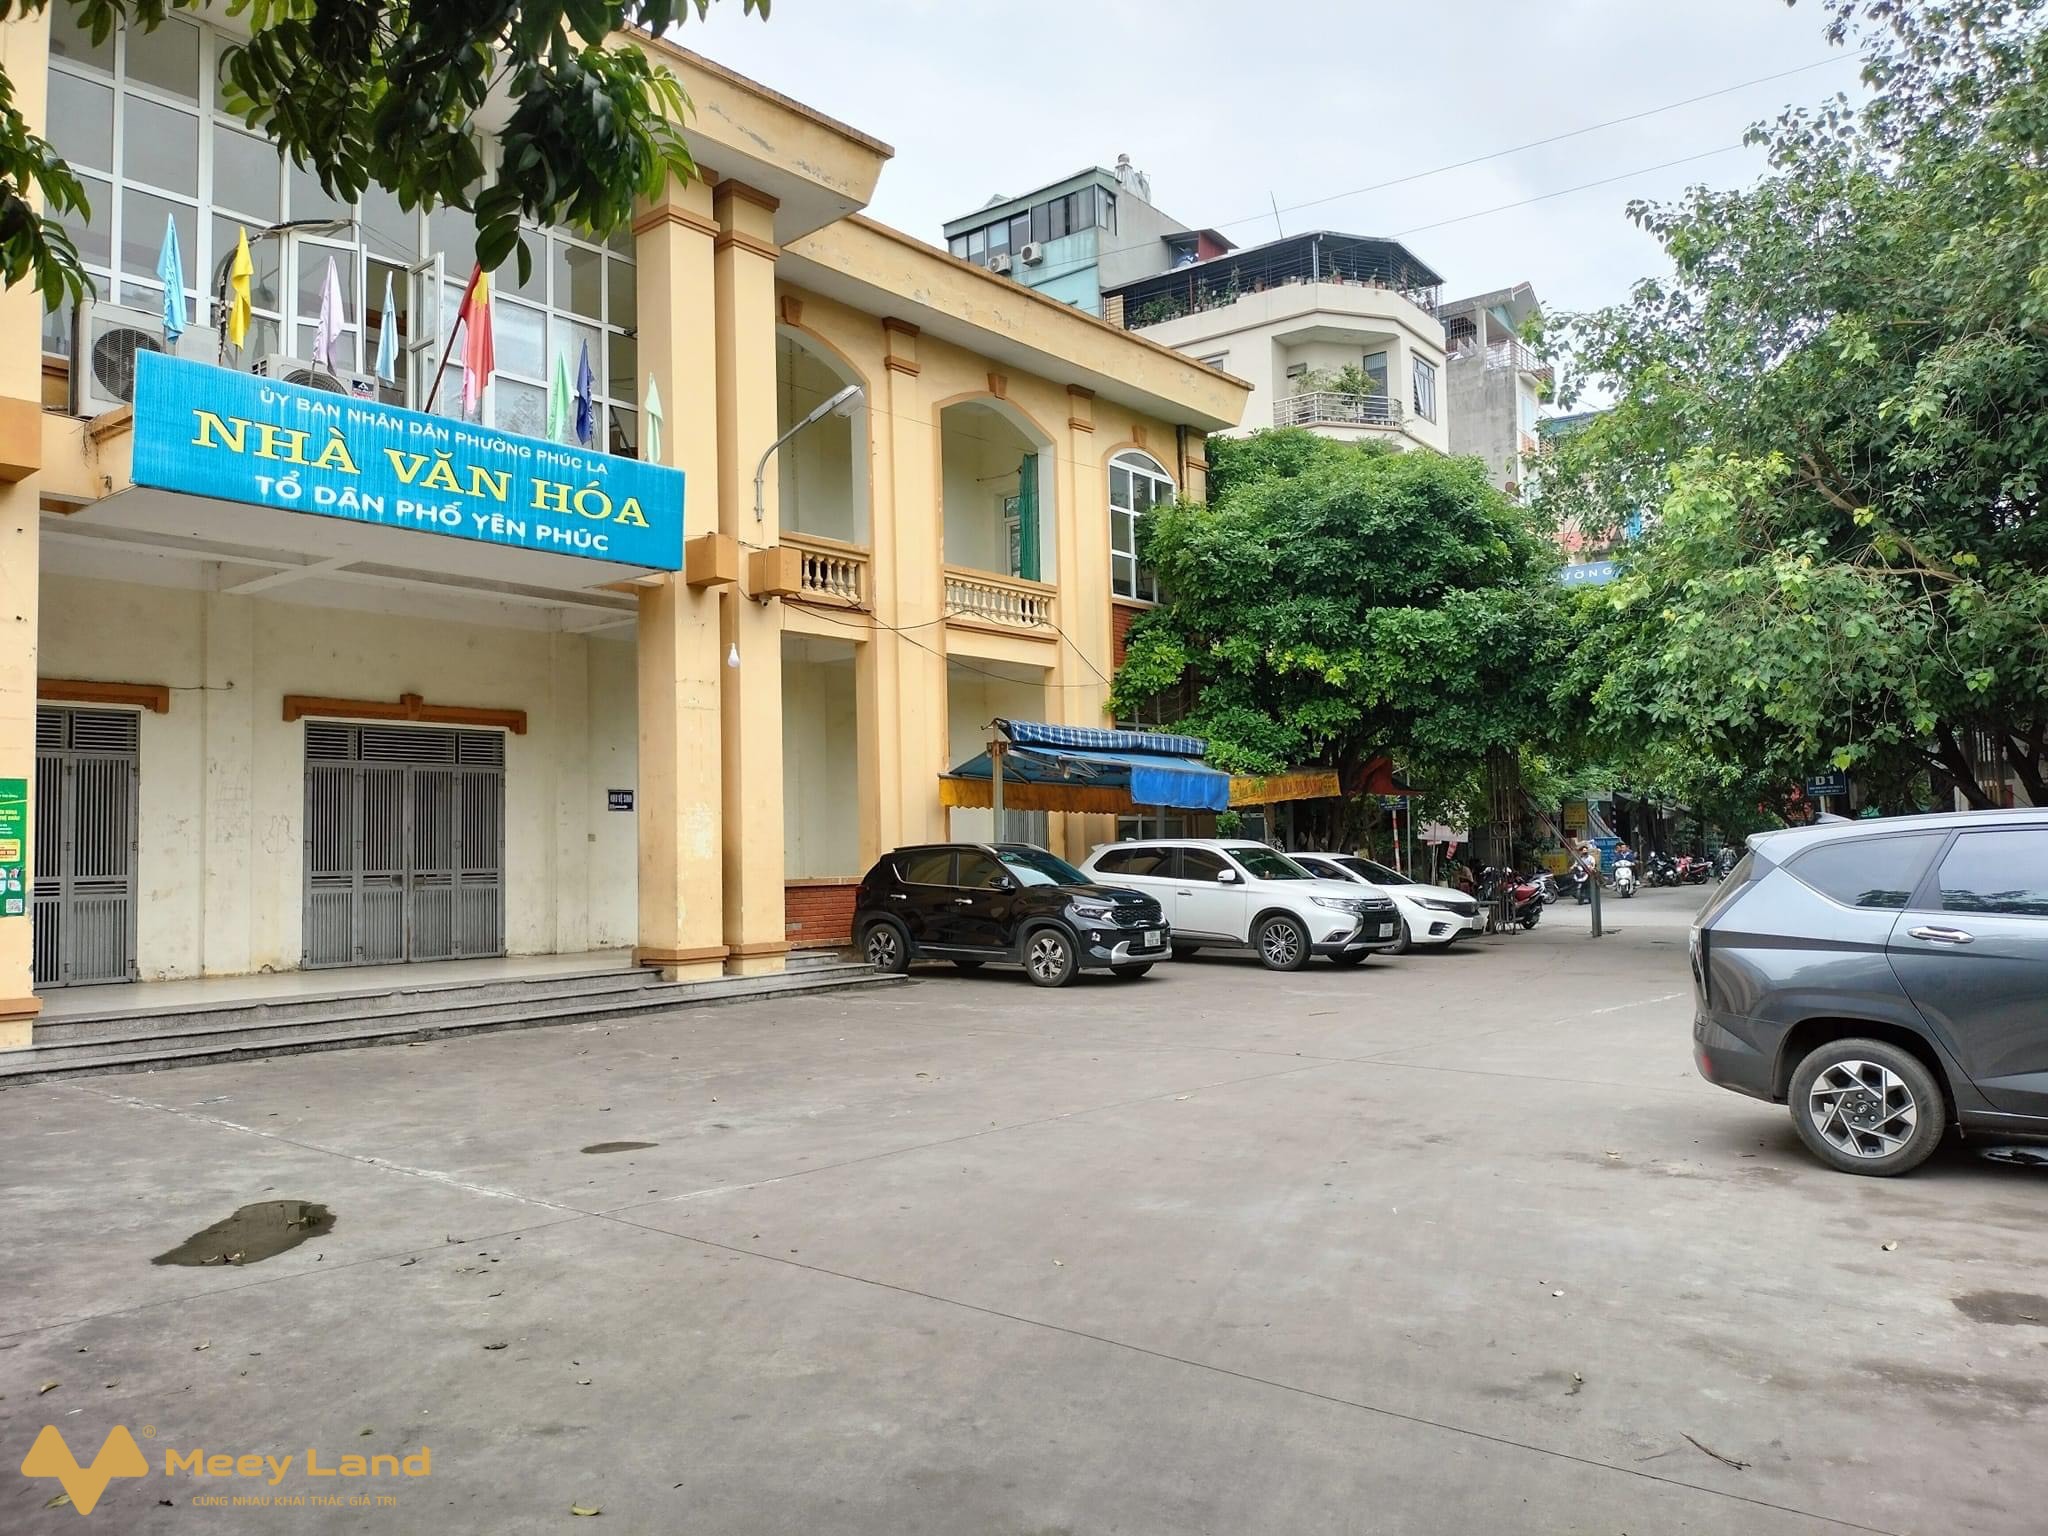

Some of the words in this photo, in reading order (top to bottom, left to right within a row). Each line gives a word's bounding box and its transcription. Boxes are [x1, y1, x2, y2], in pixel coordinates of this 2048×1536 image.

[191, 409, 361, 475] NHÀ
[384, 447, 512, 502] VĂN
[530, 477, 650, 528] HÓA
[260, 387, 290, 408] ỦY
[296, 398, 341, 418] BAN
[347, 409, 403, 431] NHÂN
[409, 422, 449, 441] DÂN
[455, 432, 532, 458] PHƯỜNG
[536, 449, 582, 469] PHÚC
[586, 460, 609, 475] LA
[255, 470, 302, 499] TỔ
[314, 486, 384, 514] DÂN
[396, 499, 463, 526] PHỐ
[472, 513, 526, 537] YÊN
[536, 525, 609, 551] PHÚC
